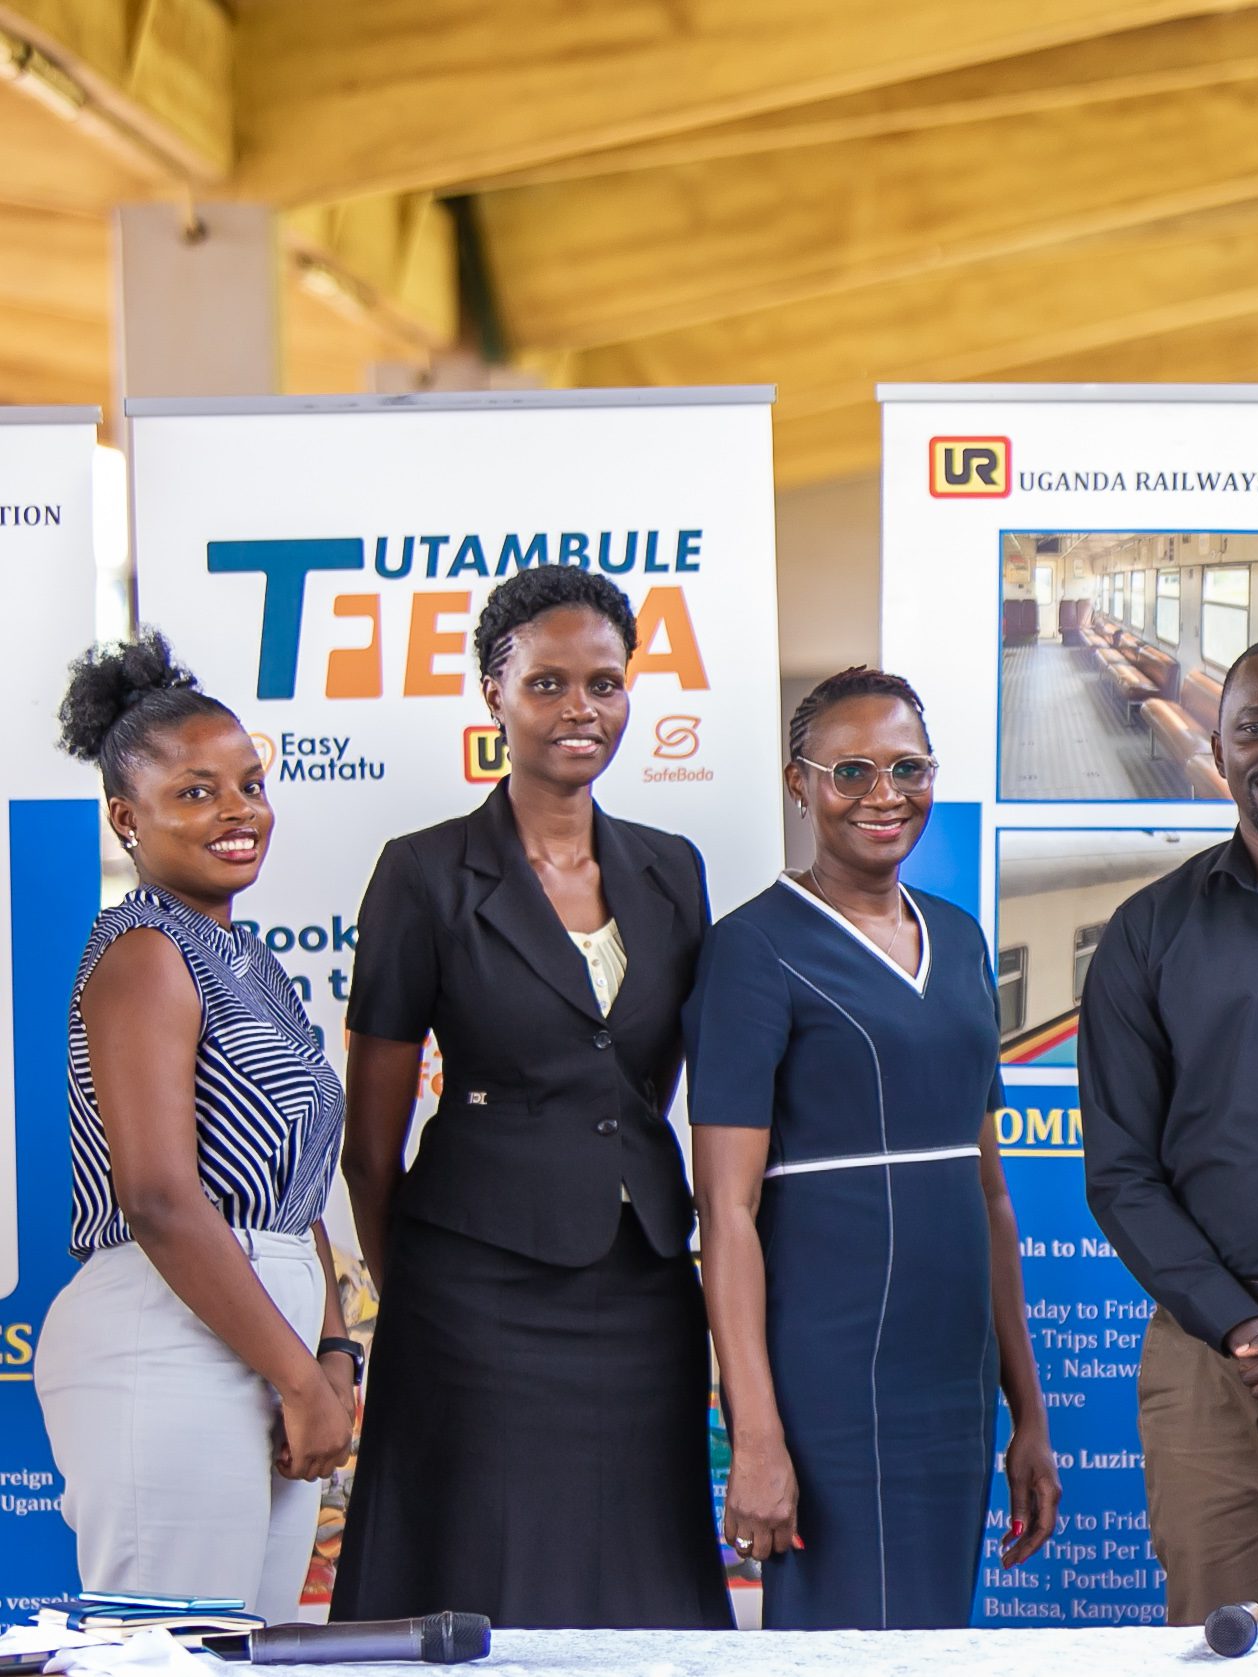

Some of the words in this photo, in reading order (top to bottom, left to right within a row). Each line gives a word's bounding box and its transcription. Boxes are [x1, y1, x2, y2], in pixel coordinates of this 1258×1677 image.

[944, 448, 1000, 486] UR
[1019, 471, 1127, 492] UGANDA
[281, 732, 351, 761] Easy
[280, 756, 385, 781] Matatu
[643, 767, 714, 784] SafeBoda
[1052, 1238, 1076, 1259] to
[1076, 1302, 1099, 1320] to
[1042, 1328, 1098, 1354] Trips
[1104, 1328, 1141, 1349] Per
[1075, 1511, 1098, 1531] to
[1103, 1509, 1151, 1531] Frid
[1044, 1540, 1098, 1565] Trips
[1103, 1540, 1140, 1561] Per
[983, 1568, 1040, 1589] Halts
[1062, 1568, 1147, 1590] Portbell
[984, 1597, 1067, 1621] Bukasa,
